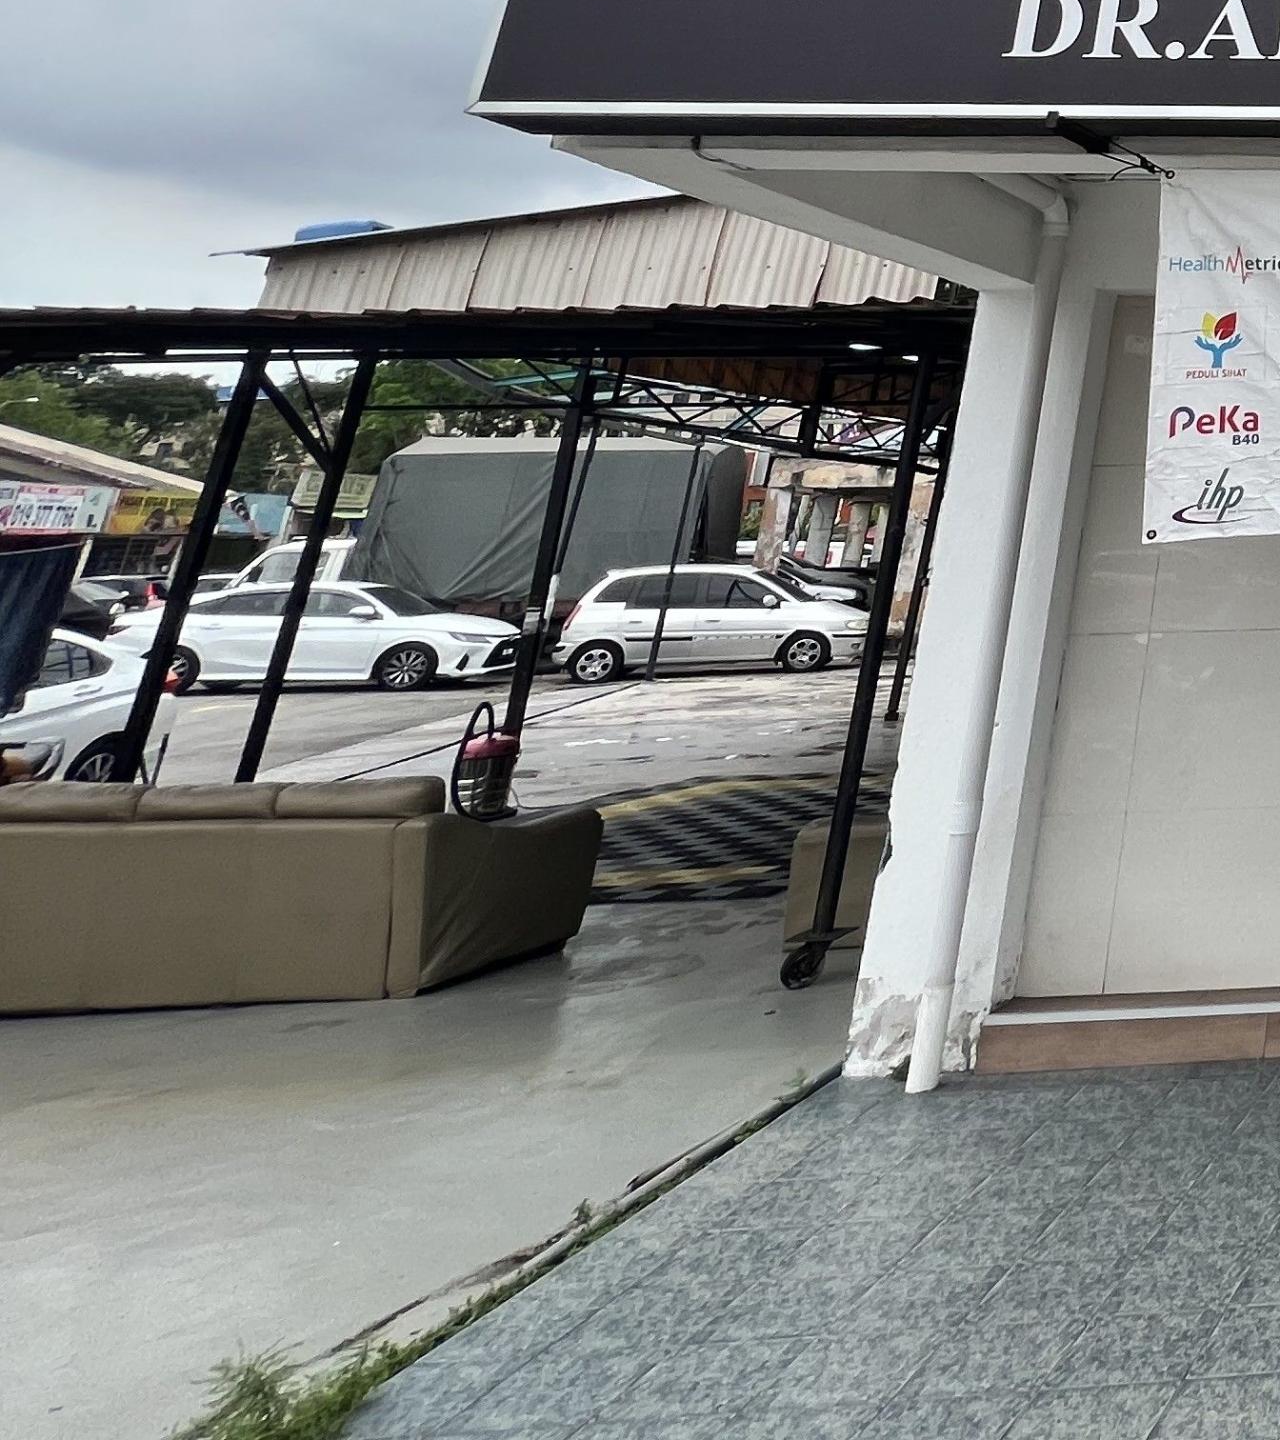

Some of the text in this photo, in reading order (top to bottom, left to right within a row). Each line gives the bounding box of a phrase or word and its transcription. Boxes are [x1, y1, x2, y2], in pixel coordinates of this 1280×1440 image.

[1186, 368, 1247, 379] PEDULI SIHAT
[1168, 405, 1260, 439] PeKa
[1232, 433, 1260, 446] B40
[1196, 466, 1245, 522] ihp
